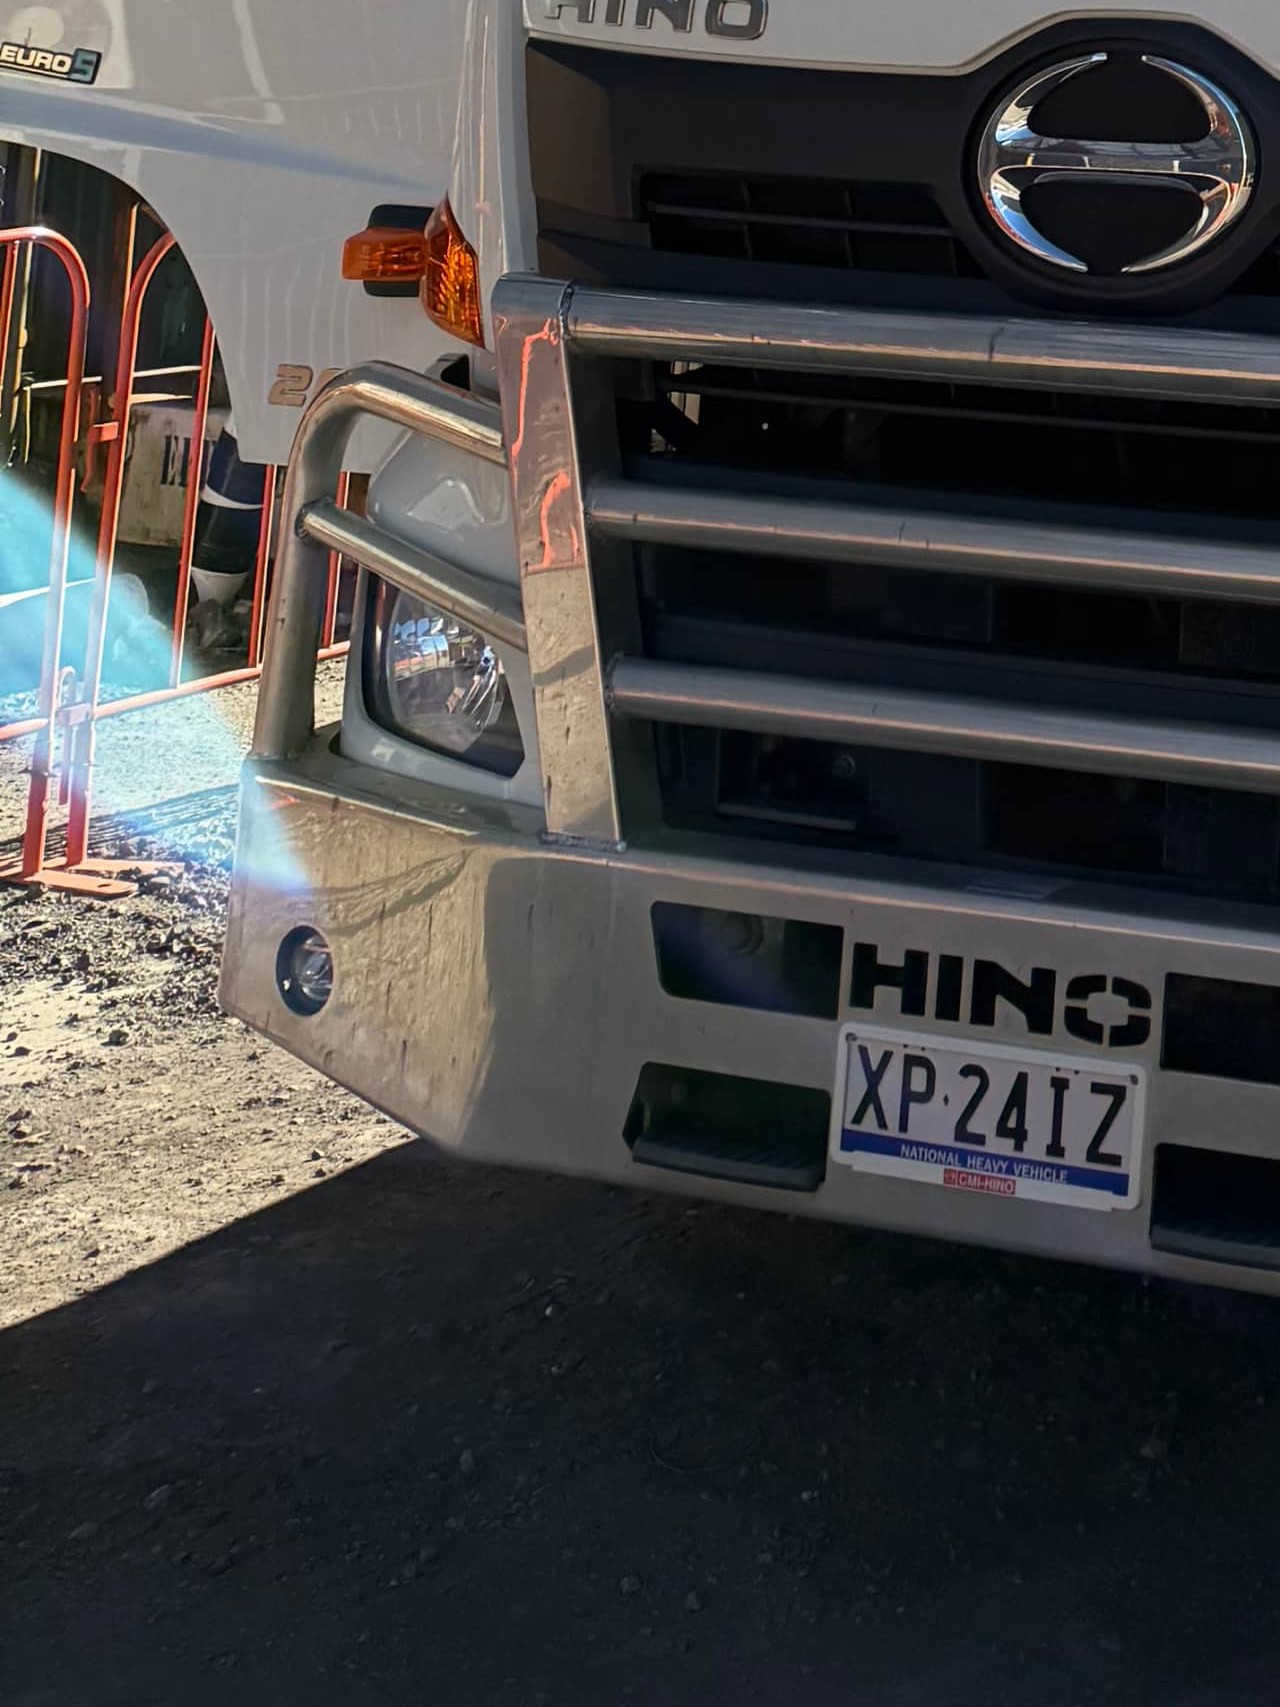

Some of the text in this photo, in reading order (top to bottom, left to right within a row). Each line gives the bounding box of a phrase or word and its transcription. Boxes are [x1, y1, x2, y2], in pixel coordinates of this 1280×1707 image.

[849, 943, 1152, 1048] HINO
[901, 1143, 1068, 1184] NATIONAL HEAVY VEHICLE
[958, 1172, 1015, 1194] CMI-HINO
